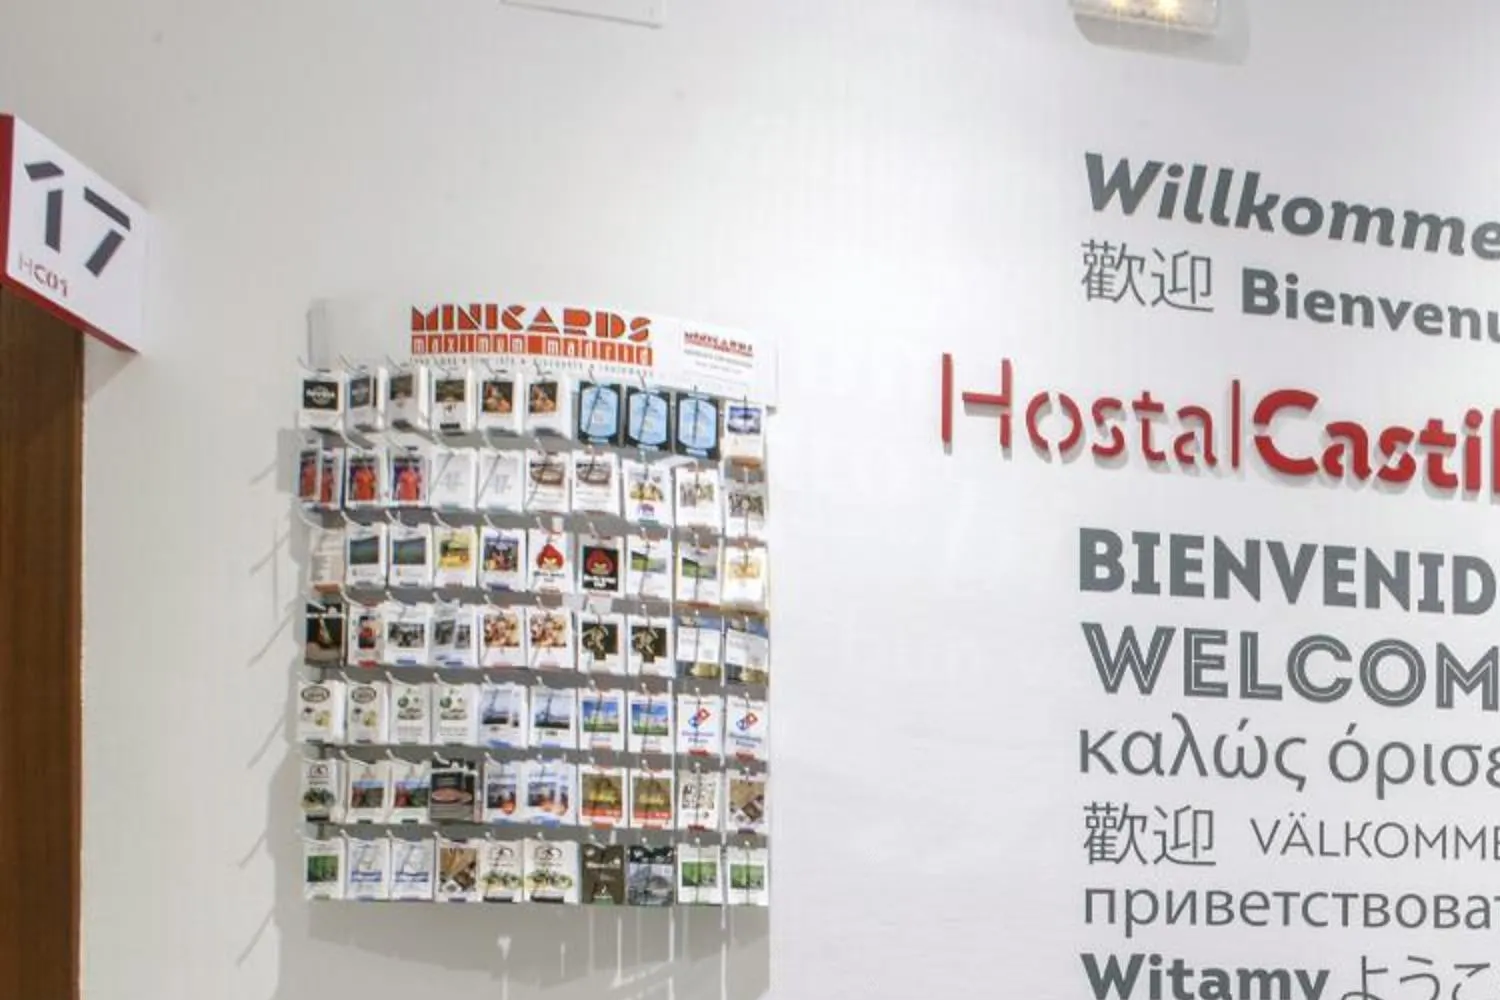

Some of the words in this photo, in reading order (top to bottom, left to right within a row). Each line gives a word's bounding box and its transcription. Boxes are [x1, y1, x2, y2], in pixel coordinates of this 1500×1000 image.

[25, 161, 131, 278] 17
[18, 251, 69, 298] HC01
[1081, 239, 1214, 313] 歡迎
[412, 303, 652, 342] MINICARDS
[1079, 712, 1308, 793] καλώς
[1083, 801, 1217, 867] 歡迎
